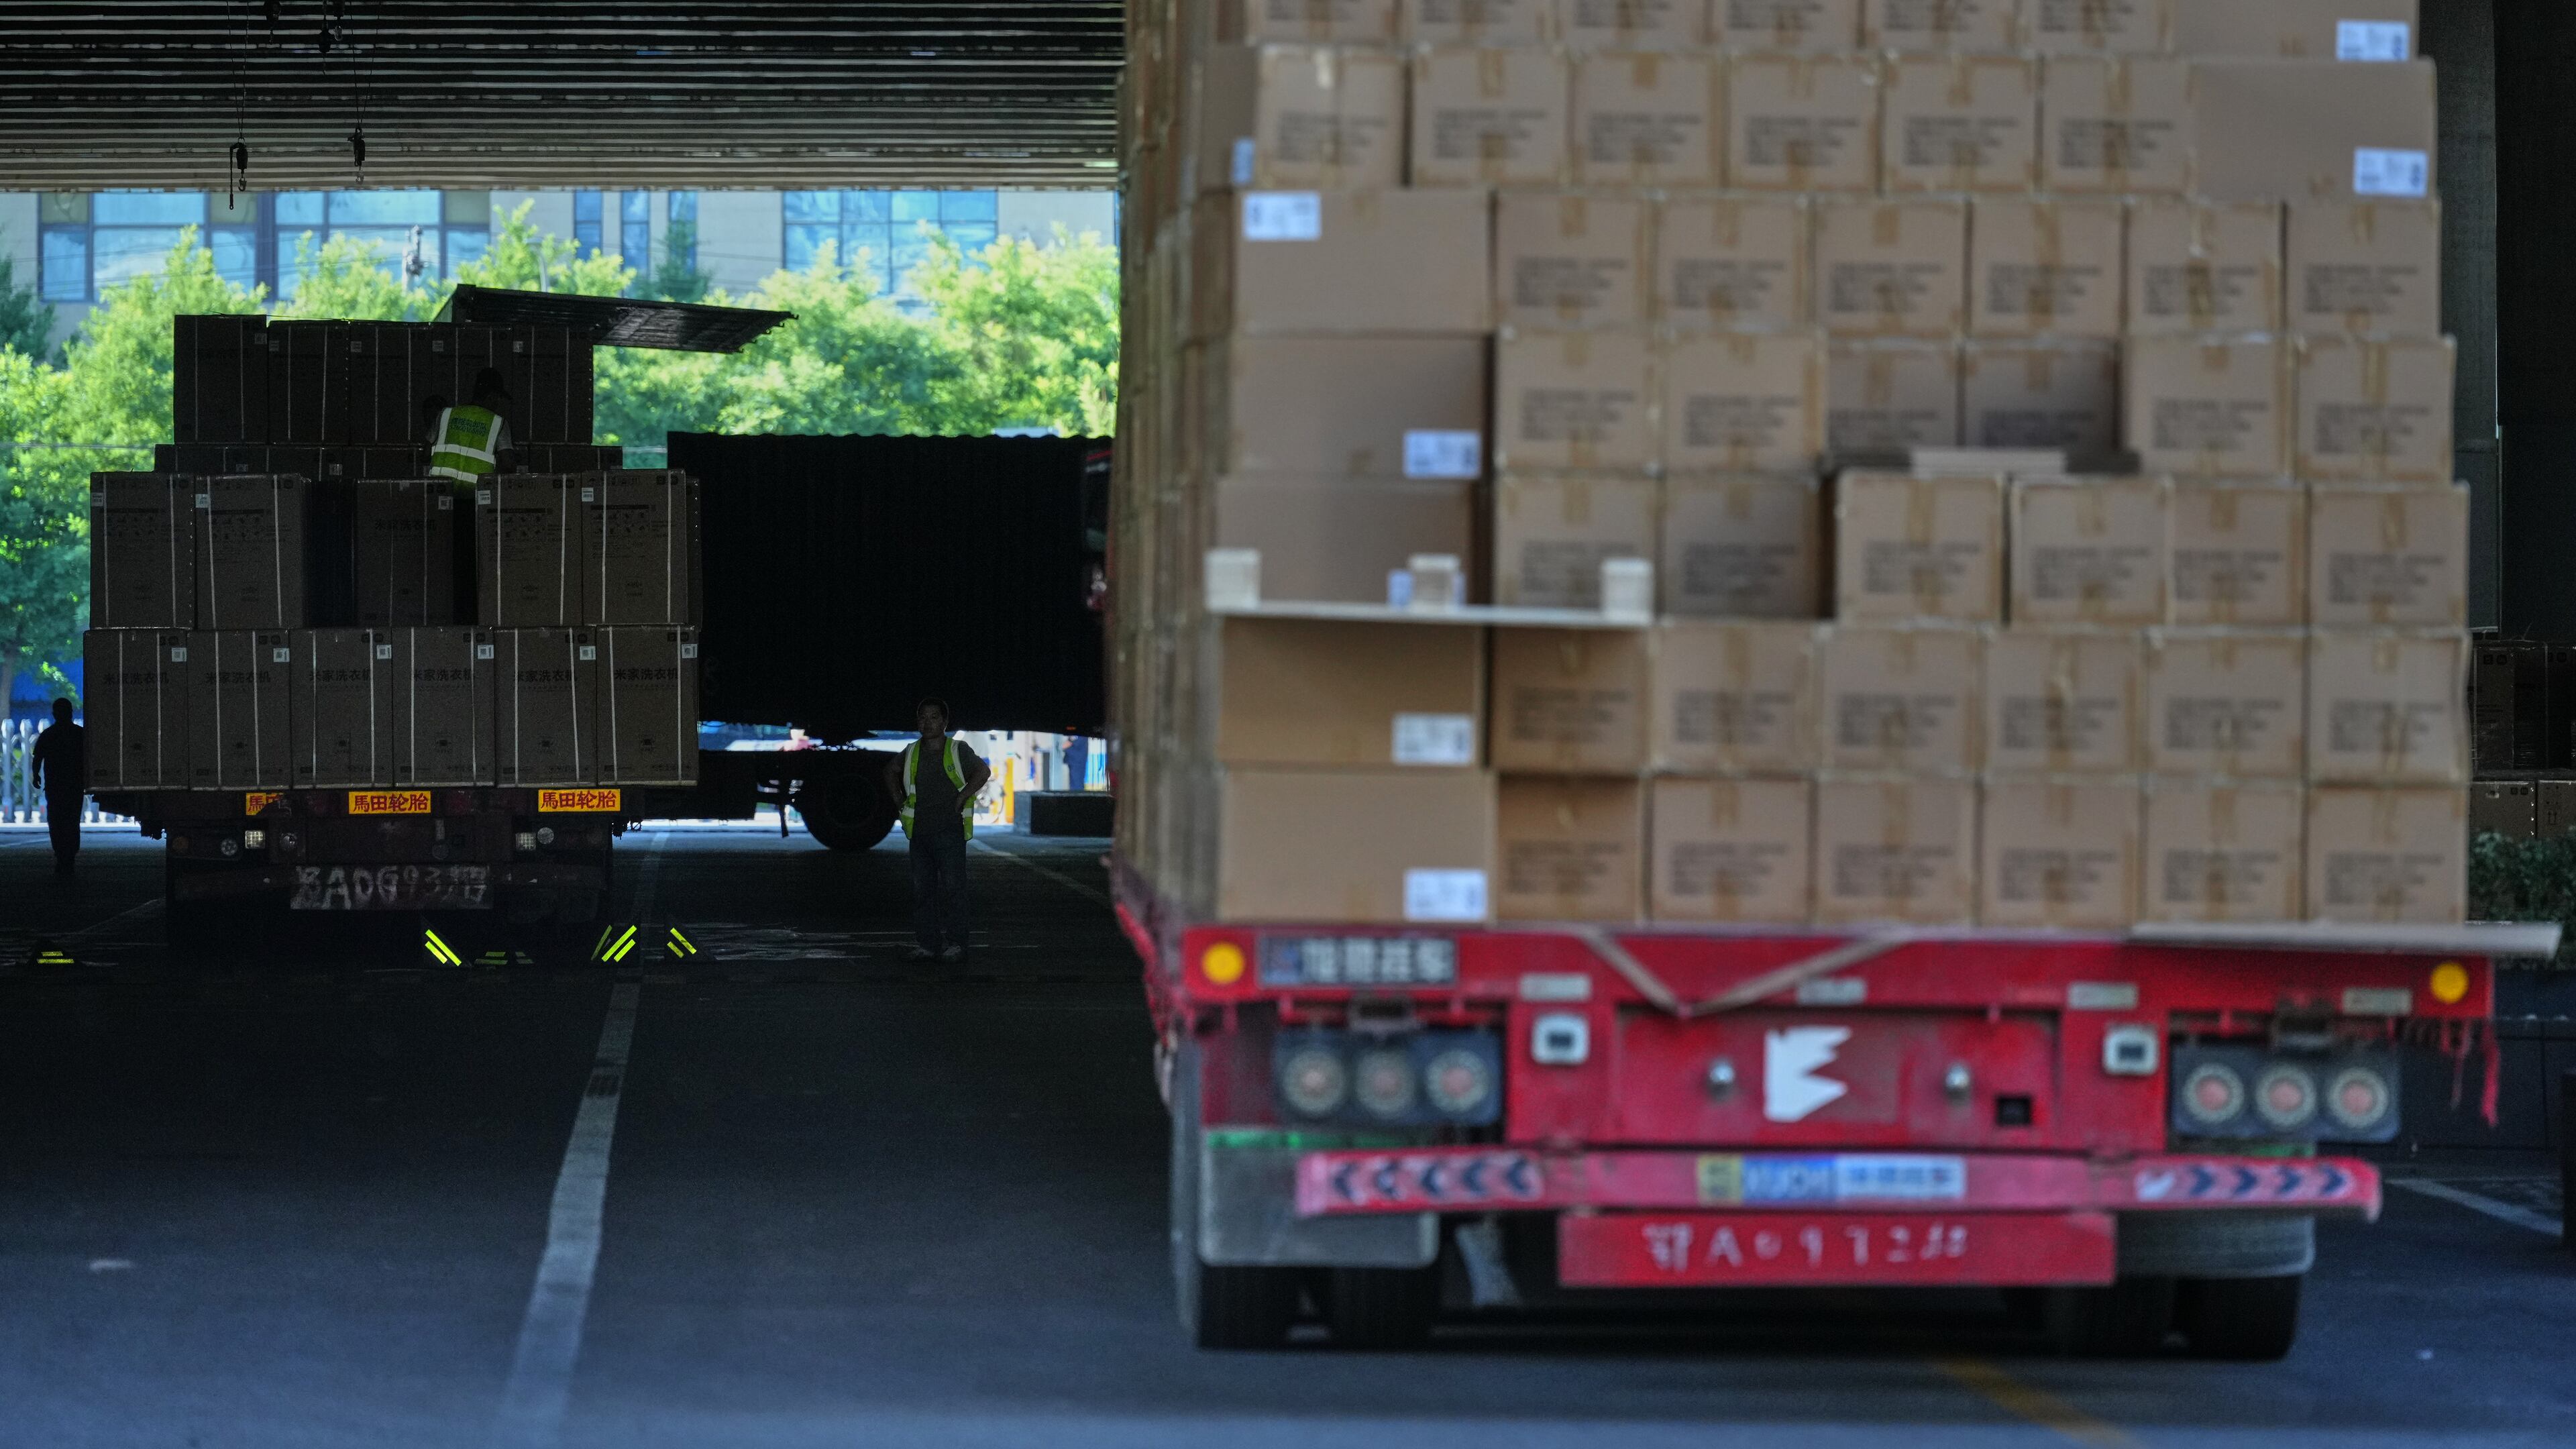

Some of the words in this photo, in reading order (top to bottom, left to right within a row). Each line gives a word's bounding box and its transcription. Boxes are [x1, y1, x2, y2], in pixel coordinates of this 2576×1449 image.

[613, 668, 679, 681] 米家洗衣机
[354, 793, 429, 812] 馬田轮胎
[541, 790, 616, 809] 馬田轮胎
